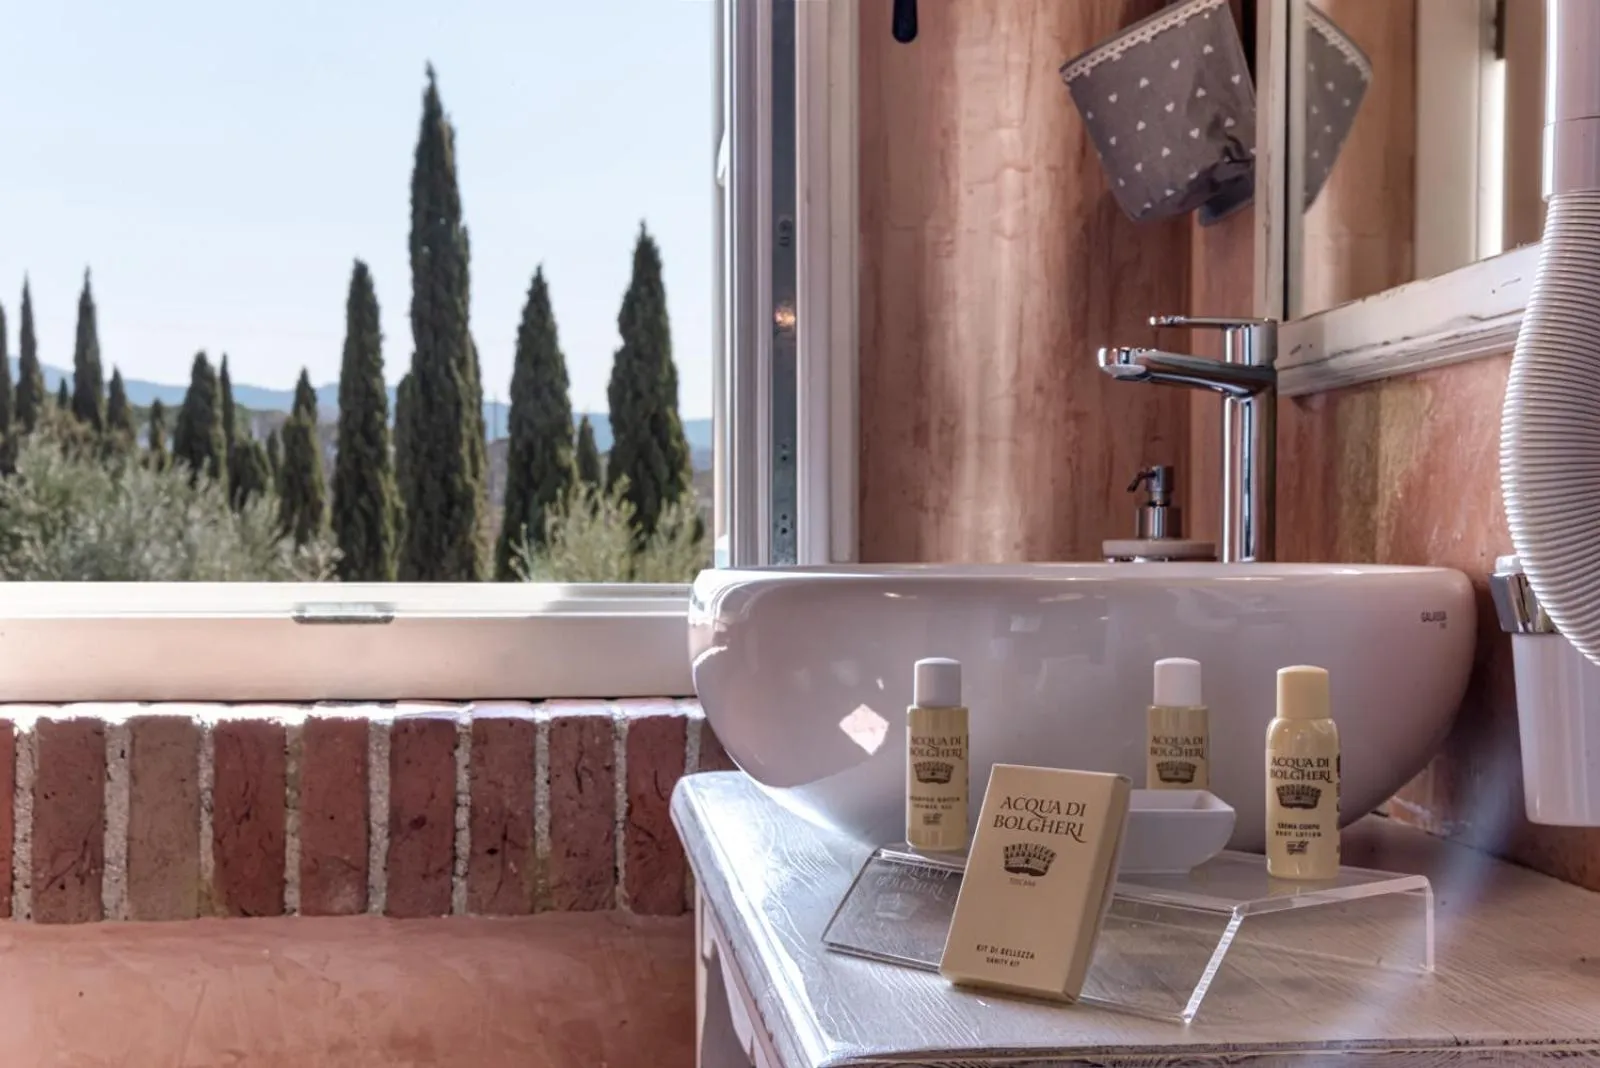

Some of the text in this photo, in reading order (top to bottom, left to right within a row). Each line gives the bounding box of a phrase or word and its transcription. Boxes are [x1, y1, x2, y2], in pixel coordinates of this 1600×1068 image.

[1151, 735, 1190, 748] ACQUA
[1271, 755, 1328, 772] ACQUA DI
[1270, 768, 1334, 784] BOLGHERI
[1000, 796, 1088, 818] ACQUA DI
[993, 814, 1088, 844] BOLGHERI
